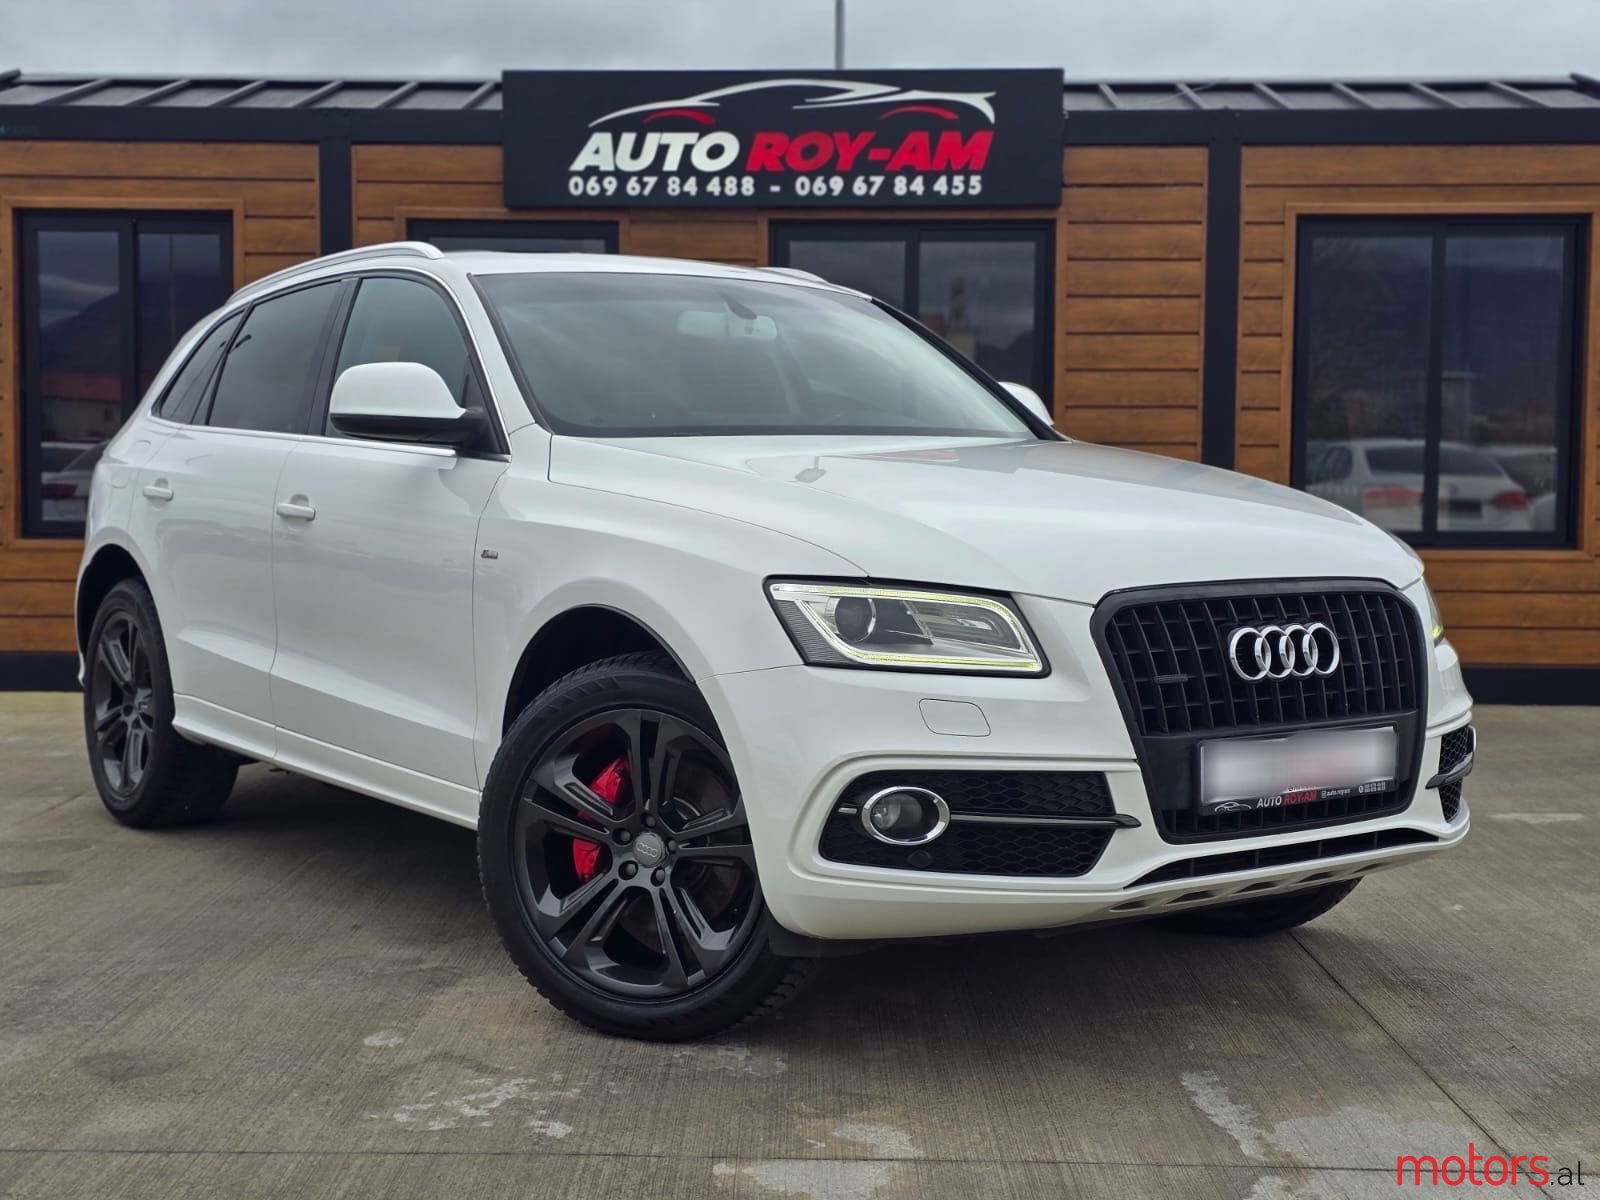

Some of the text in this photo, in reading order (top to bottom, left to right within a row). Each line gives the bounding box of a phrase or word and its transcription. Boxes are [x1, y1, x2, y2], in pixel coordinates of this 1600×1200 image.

[569, 130, 994, 172] AUTO ROY-AM
[568, 175, 618, 197] 069
[625, 175, 659, 197] 67
[666, 175, 698, 197] 84
[705, 175, 755, 197] 488
[794, 175, 845, 197] 069
[852, 175, 885, 197] 67
[893, 175, 925, 196] 84
[932, 174, 982, 196] 455
[1256, 796, 1282, 809] AUTO
